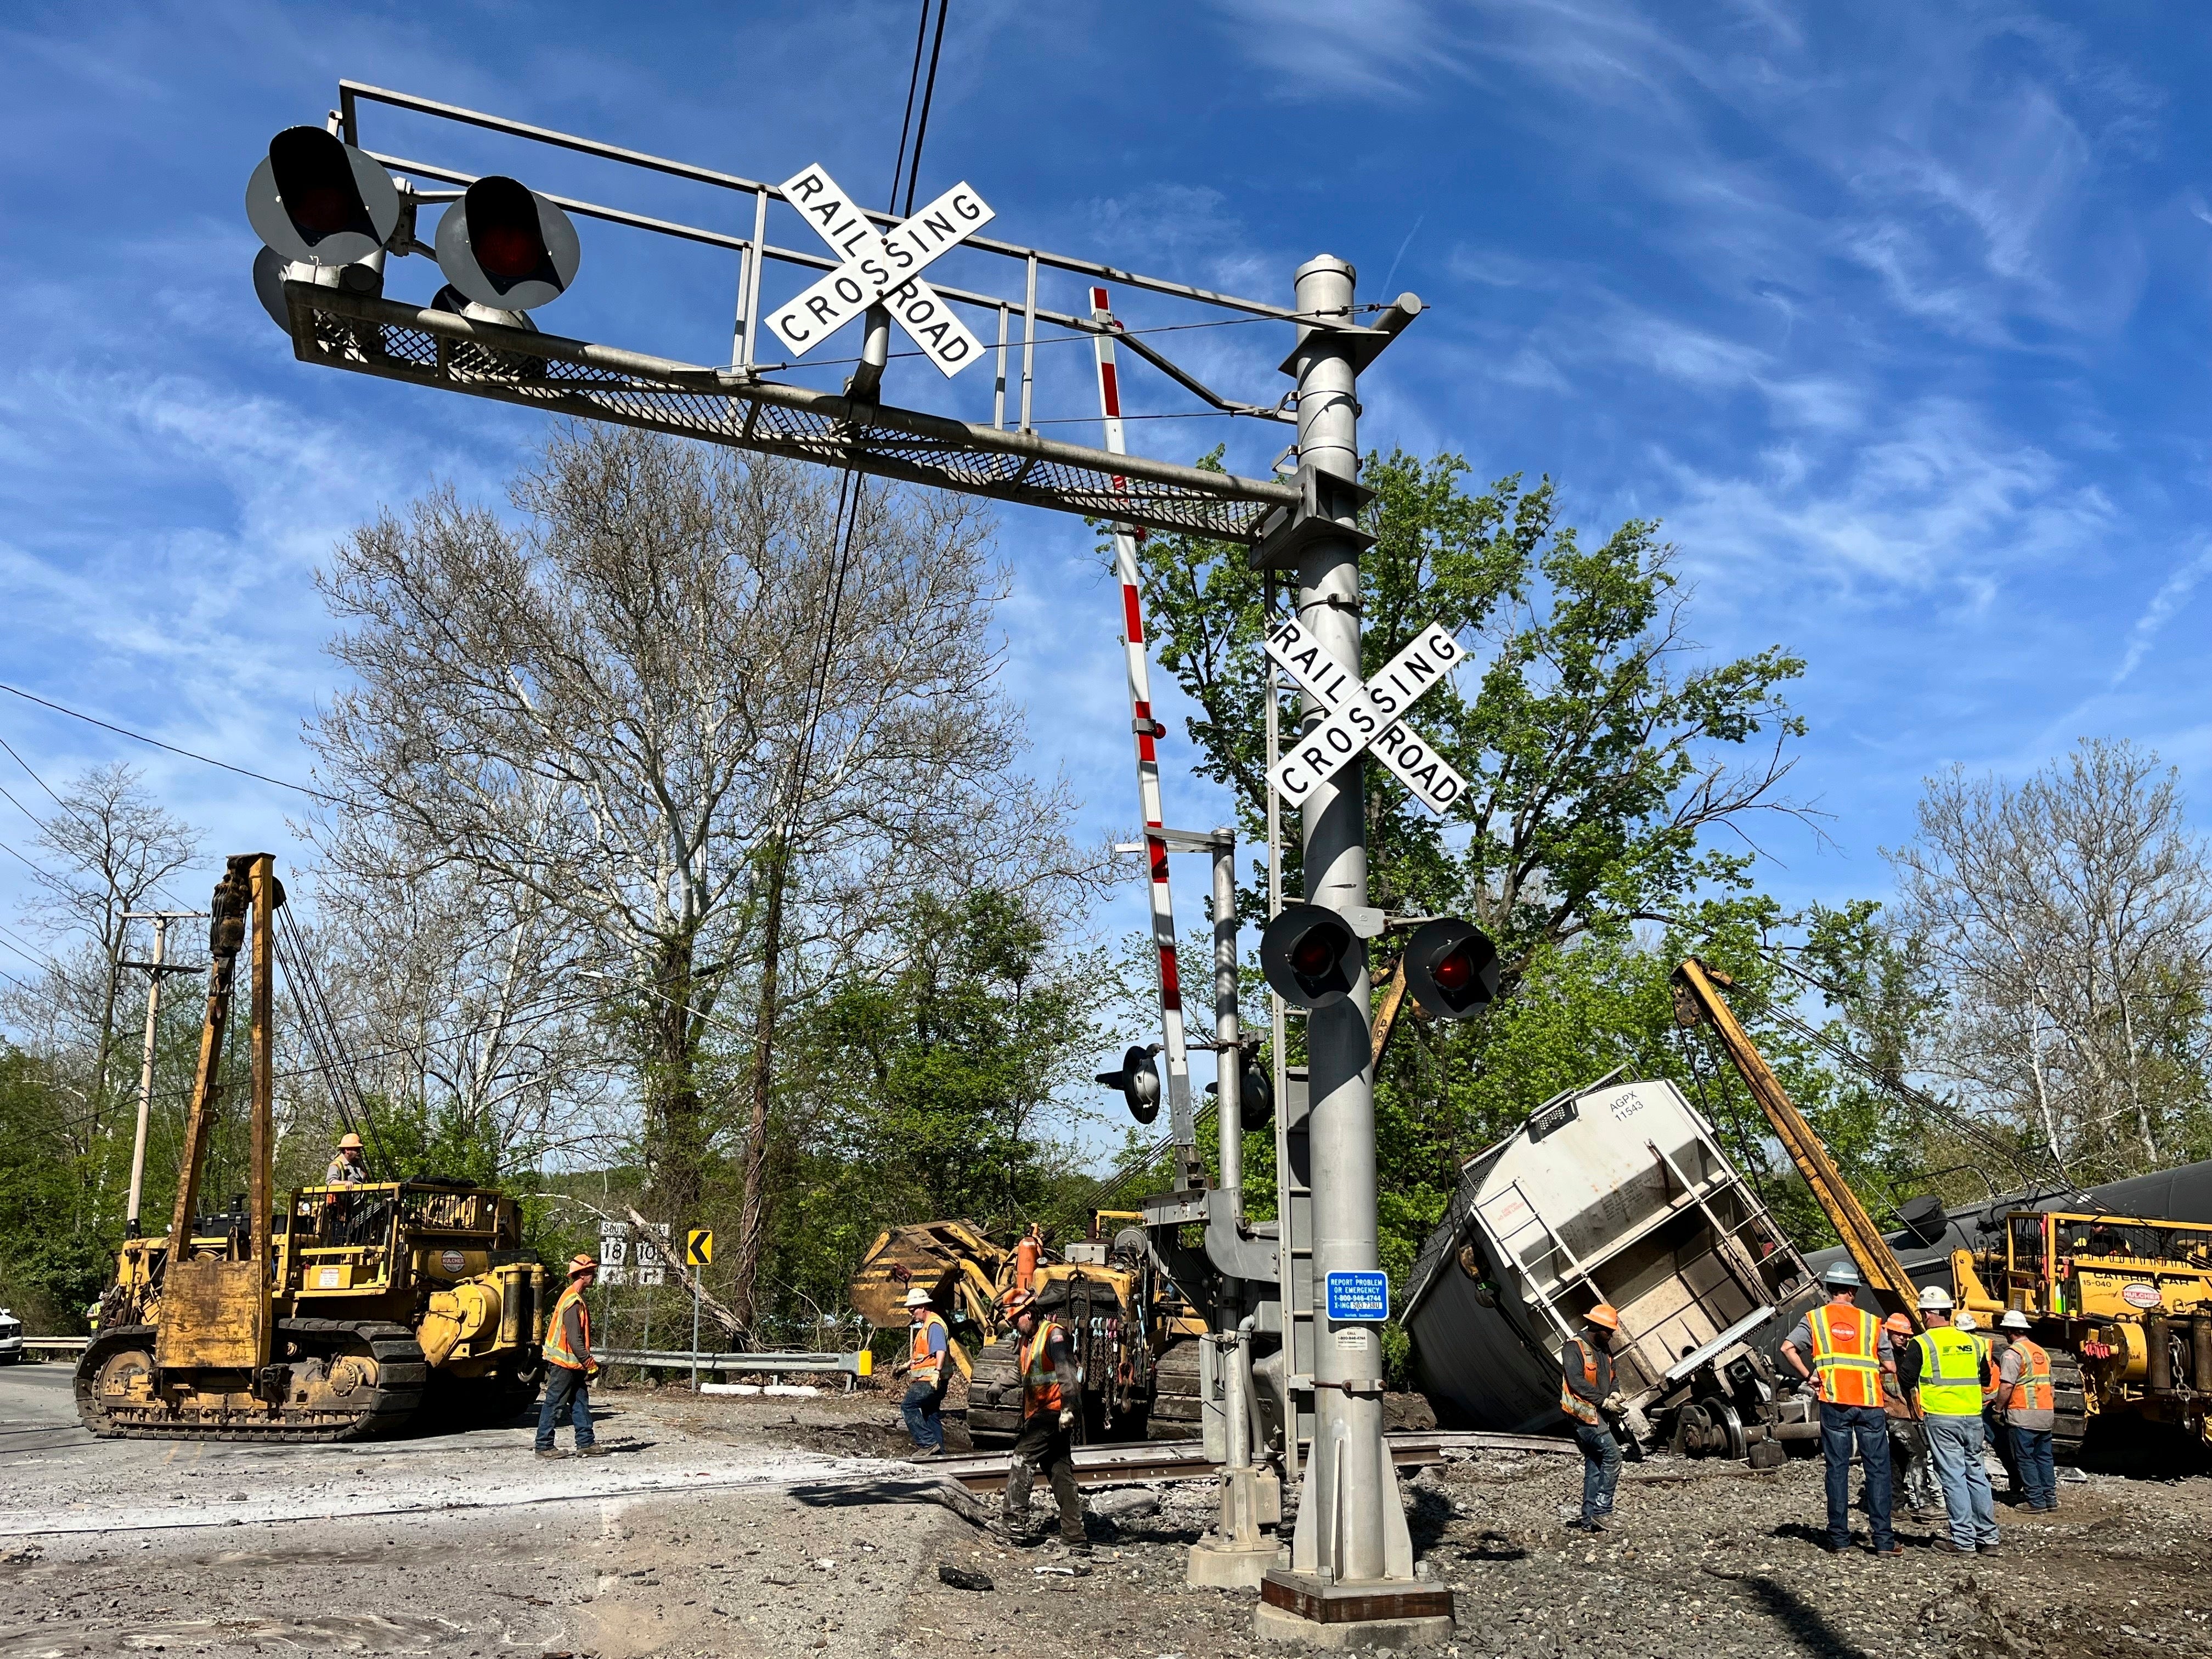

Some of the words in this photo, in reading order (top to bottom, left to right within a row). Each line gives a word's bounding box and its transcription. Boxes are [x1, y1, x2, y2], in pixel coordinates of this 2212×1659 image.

[781, 195, 980, 341] CROSSING
[792, 173, 867, 257] RAIL
[897, 280, 969, 362] ROAD
[1272, 623, 1347, 704] RAIL
[1377, 725, 1458, 803] ROAD
[1282, 635, 1455, 793] CROSSING
[1610, 1090, 1638, 1112] AGPX
[1615, 1101, 1643, 1121] 11543
[605, 1243, 622, 1259] 18
[640, 1245, 658, 1260] 10
[2083, 1279, 2112, 1288] 15-040
[2123, 1291, 2160, 1300] HULCHER
